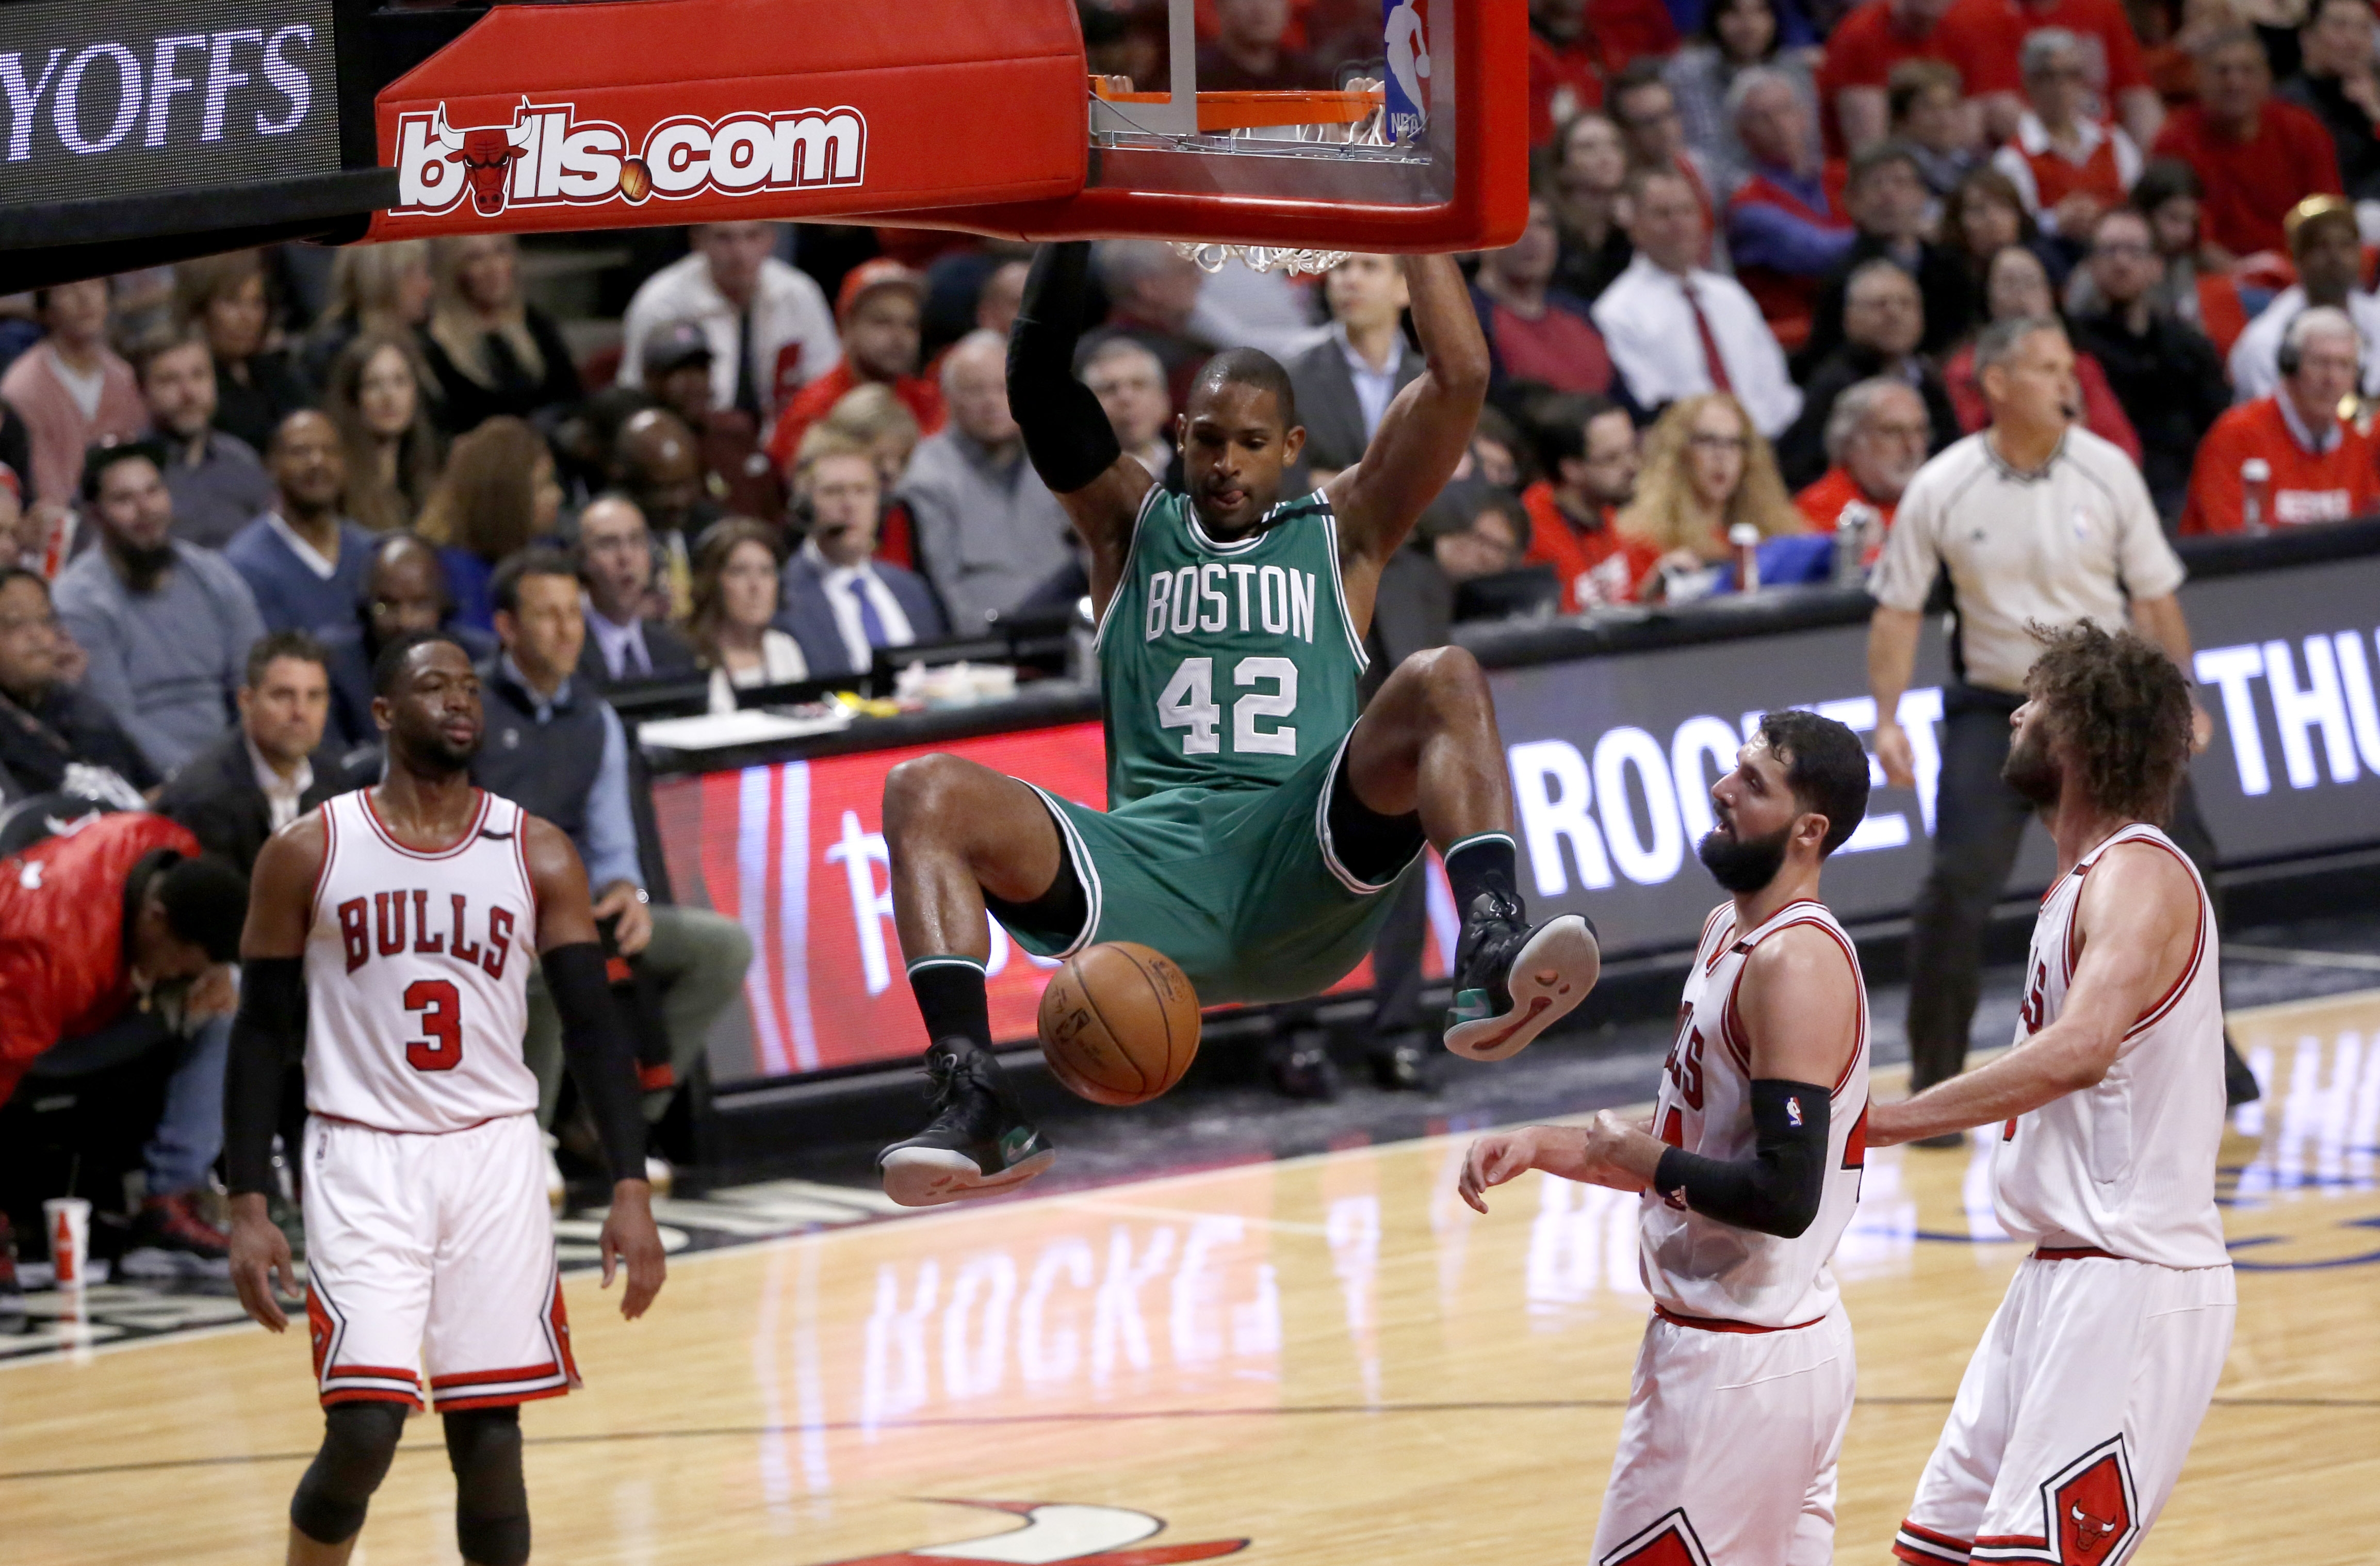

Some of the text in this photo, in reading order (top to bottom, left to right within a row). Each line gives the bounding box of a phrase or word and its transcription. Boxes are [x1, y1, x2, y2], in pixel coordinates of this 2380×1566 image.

[0, 24, 314, 161] YOFFS
[1391, 112, 1420, 134] NBA
[1146, 563, 1315, 644] BOSTON
[1156, 657, 1298, 756] 42
[1507, 686, 1944, 898] ROCET
[338, 889, 515, 981] BULLS
[404, 979, 462, 1071] 3
